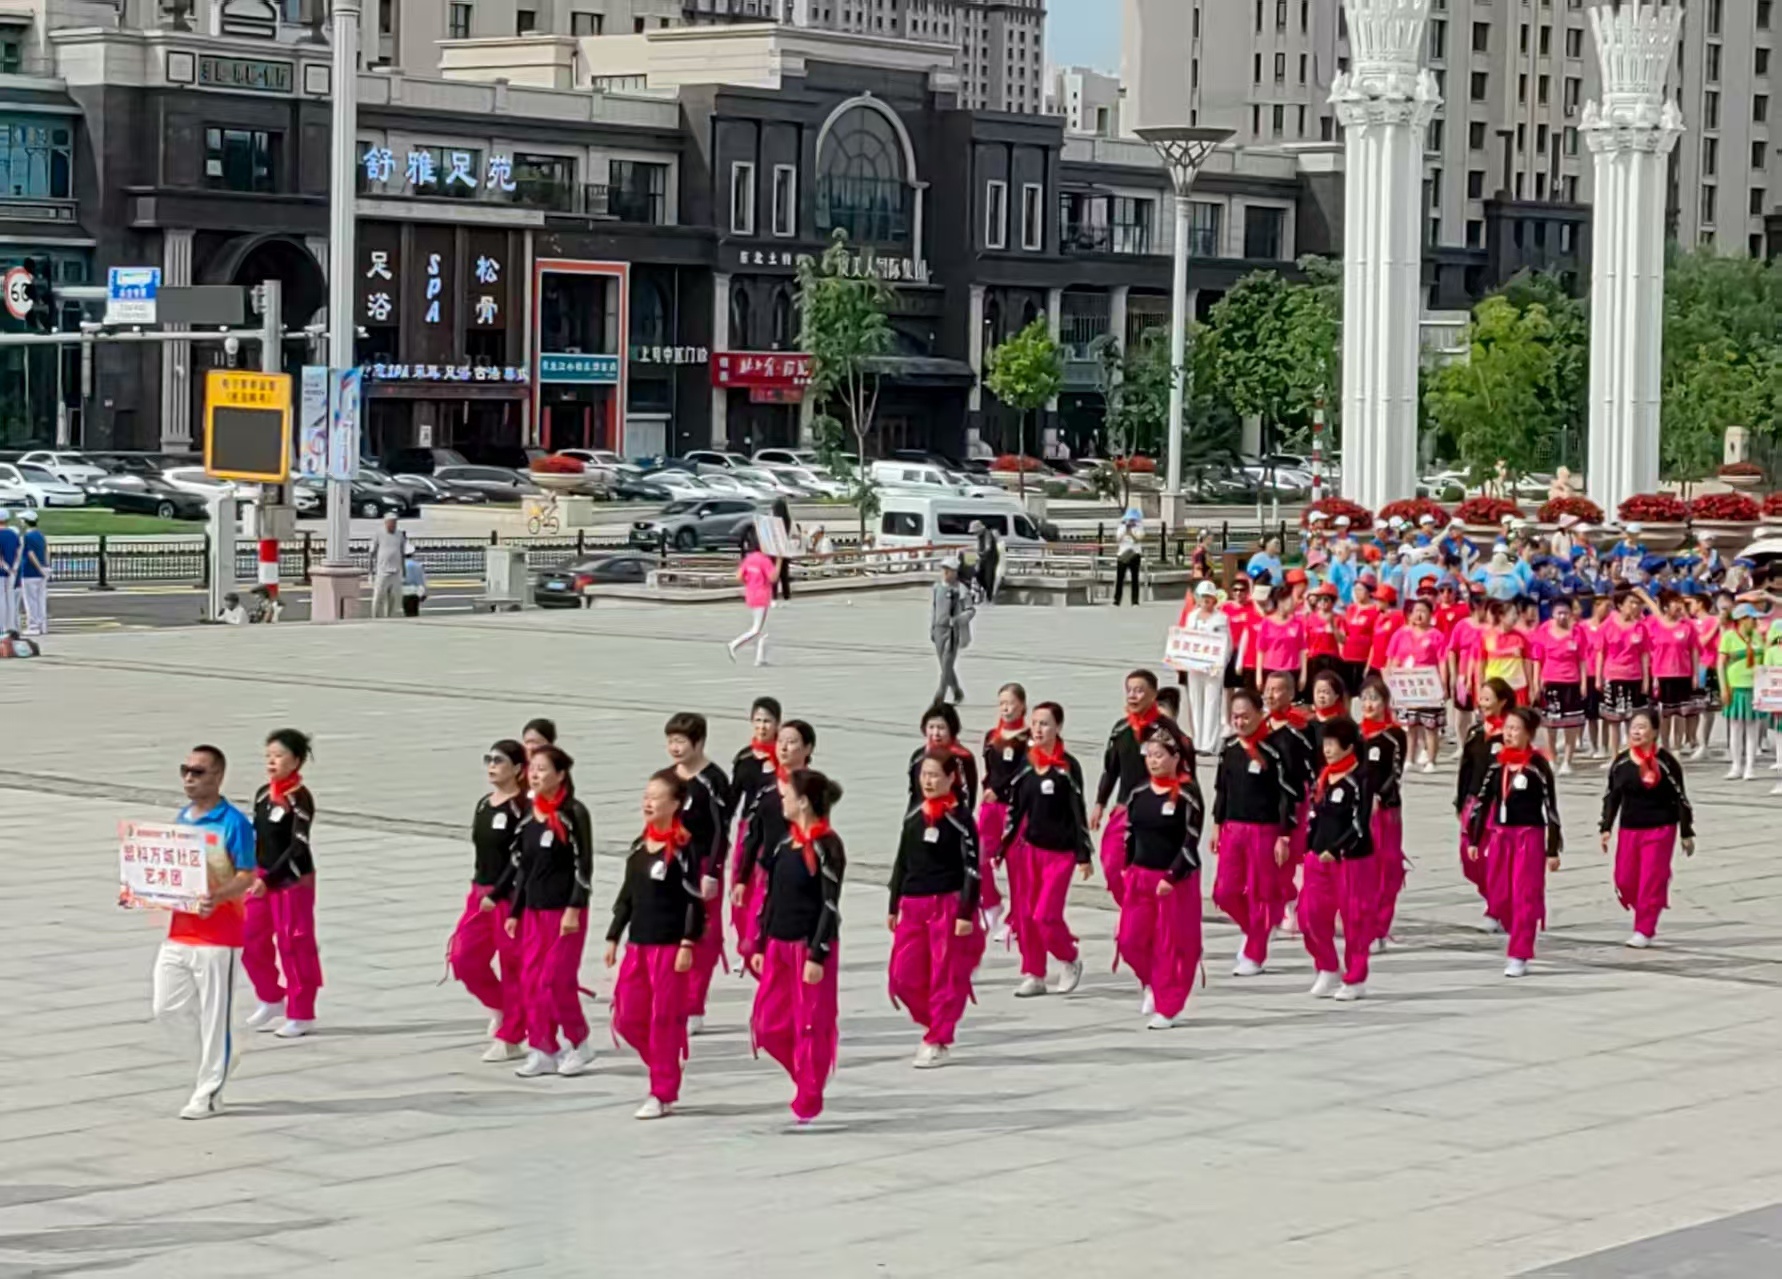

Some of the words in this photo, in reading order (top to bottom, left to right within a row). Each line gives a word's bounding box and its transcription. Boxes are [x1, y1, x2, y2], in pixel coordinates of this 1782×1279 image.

[363, 145, 517, 192] 舒雅足苑
[366, 251, 393, 322] 足浴
[425, 253, 442, 323] SPA
[475, 254, 501, 325] 松骨
